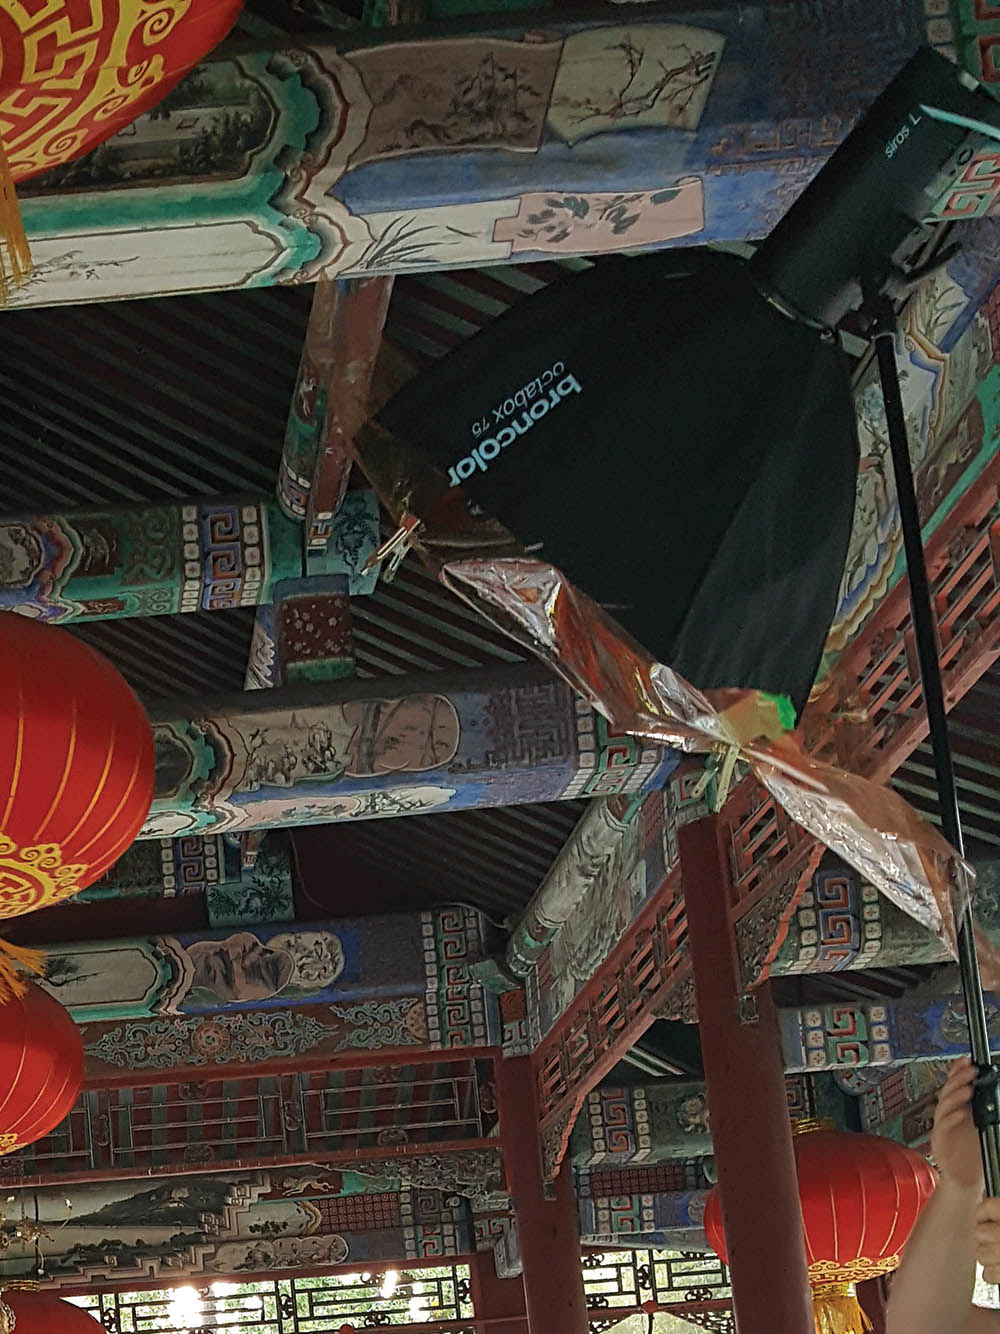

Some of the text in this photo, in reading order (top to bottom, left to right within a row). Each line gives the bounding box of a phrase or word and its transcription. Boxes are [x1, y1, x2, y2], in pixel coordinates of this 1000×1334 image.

[885, 113, 922, 158] siros L
[447, 374, 583, 487] broncolor
[472, 361, 565, 438] octabox 75
